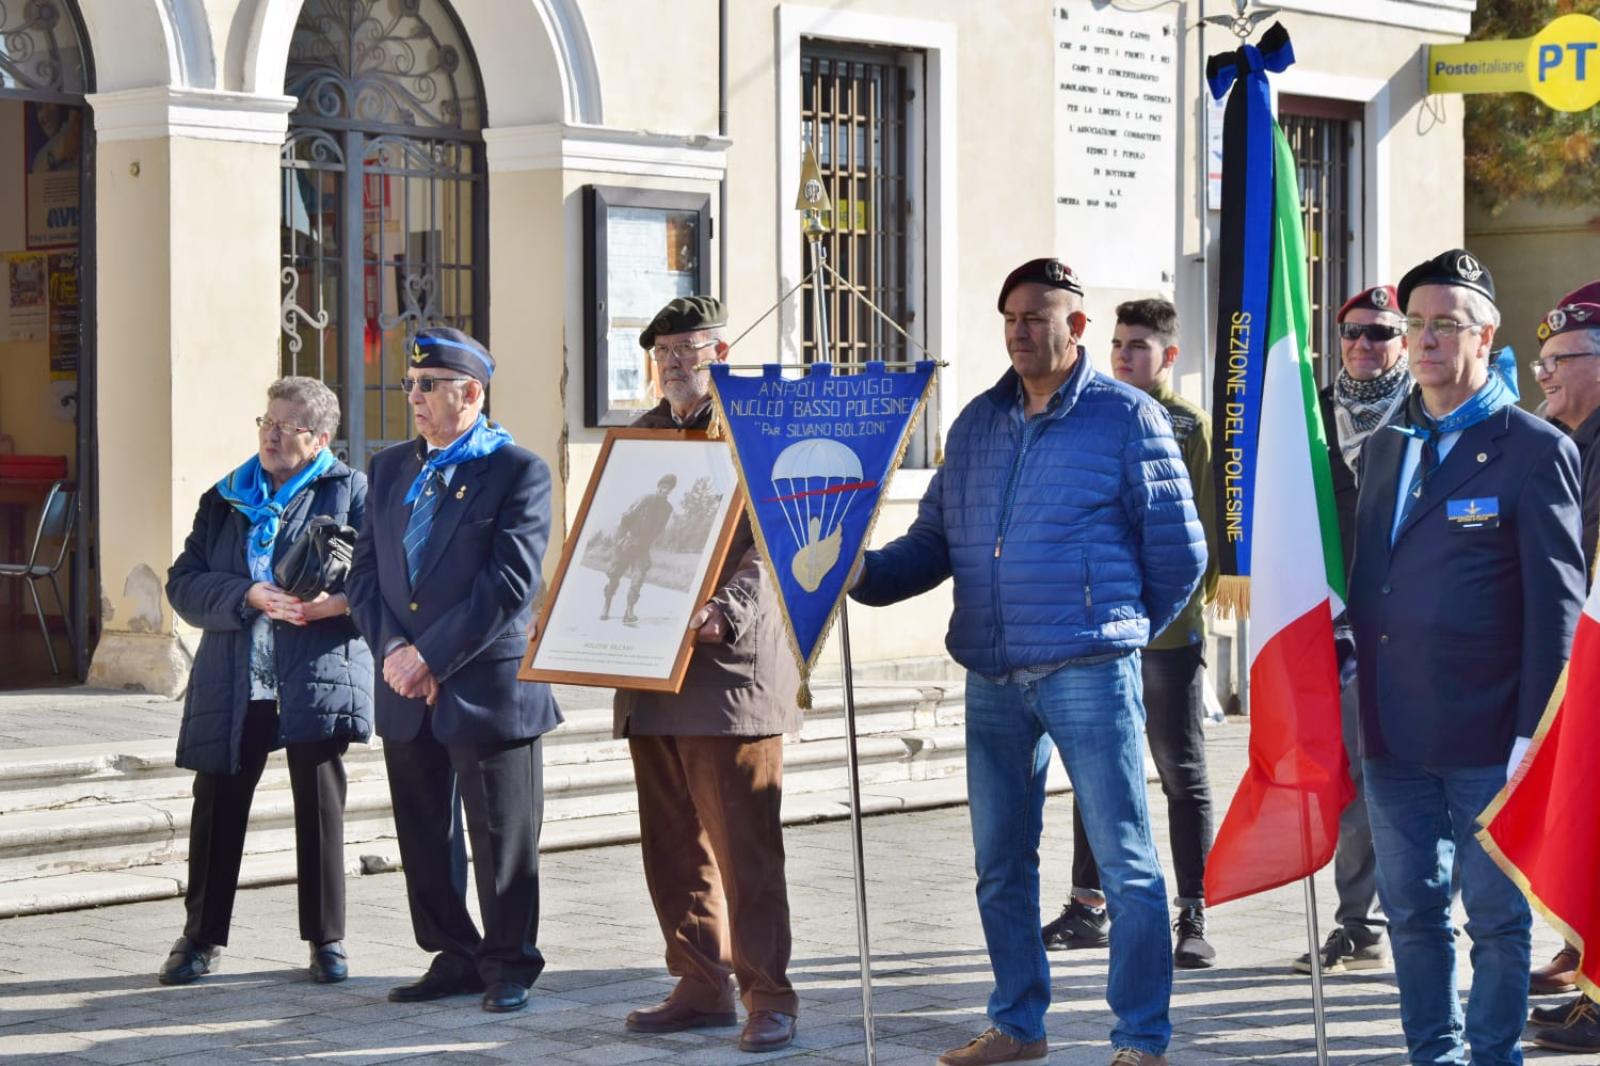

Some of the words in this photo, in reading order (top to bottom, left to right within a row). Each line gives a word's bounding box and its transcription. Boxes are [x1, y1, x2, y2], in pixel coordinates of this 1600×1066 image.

[1538, 42, 1598, 82] PT
[1102, 88, 1111, 96] LA
[1066, 103, 1079, 113] PER
[1084, 105, 1093, 114] LA
[1135, 112, 1143, 120] LA
[1148, 113, 1163, 123] PACE
[47, 207, 81, 228] AVI
[1226, 311, 1252, 396] SEZIONE
[823, 378, 893, 398] ROVIGO
[730, 399, 784, 417] NUCLEO
[786, 421, 832, 438] SILVANO
[1224, 402, 1245, 442] DEL
[1224, 448, 1244, 543] POLESINE
